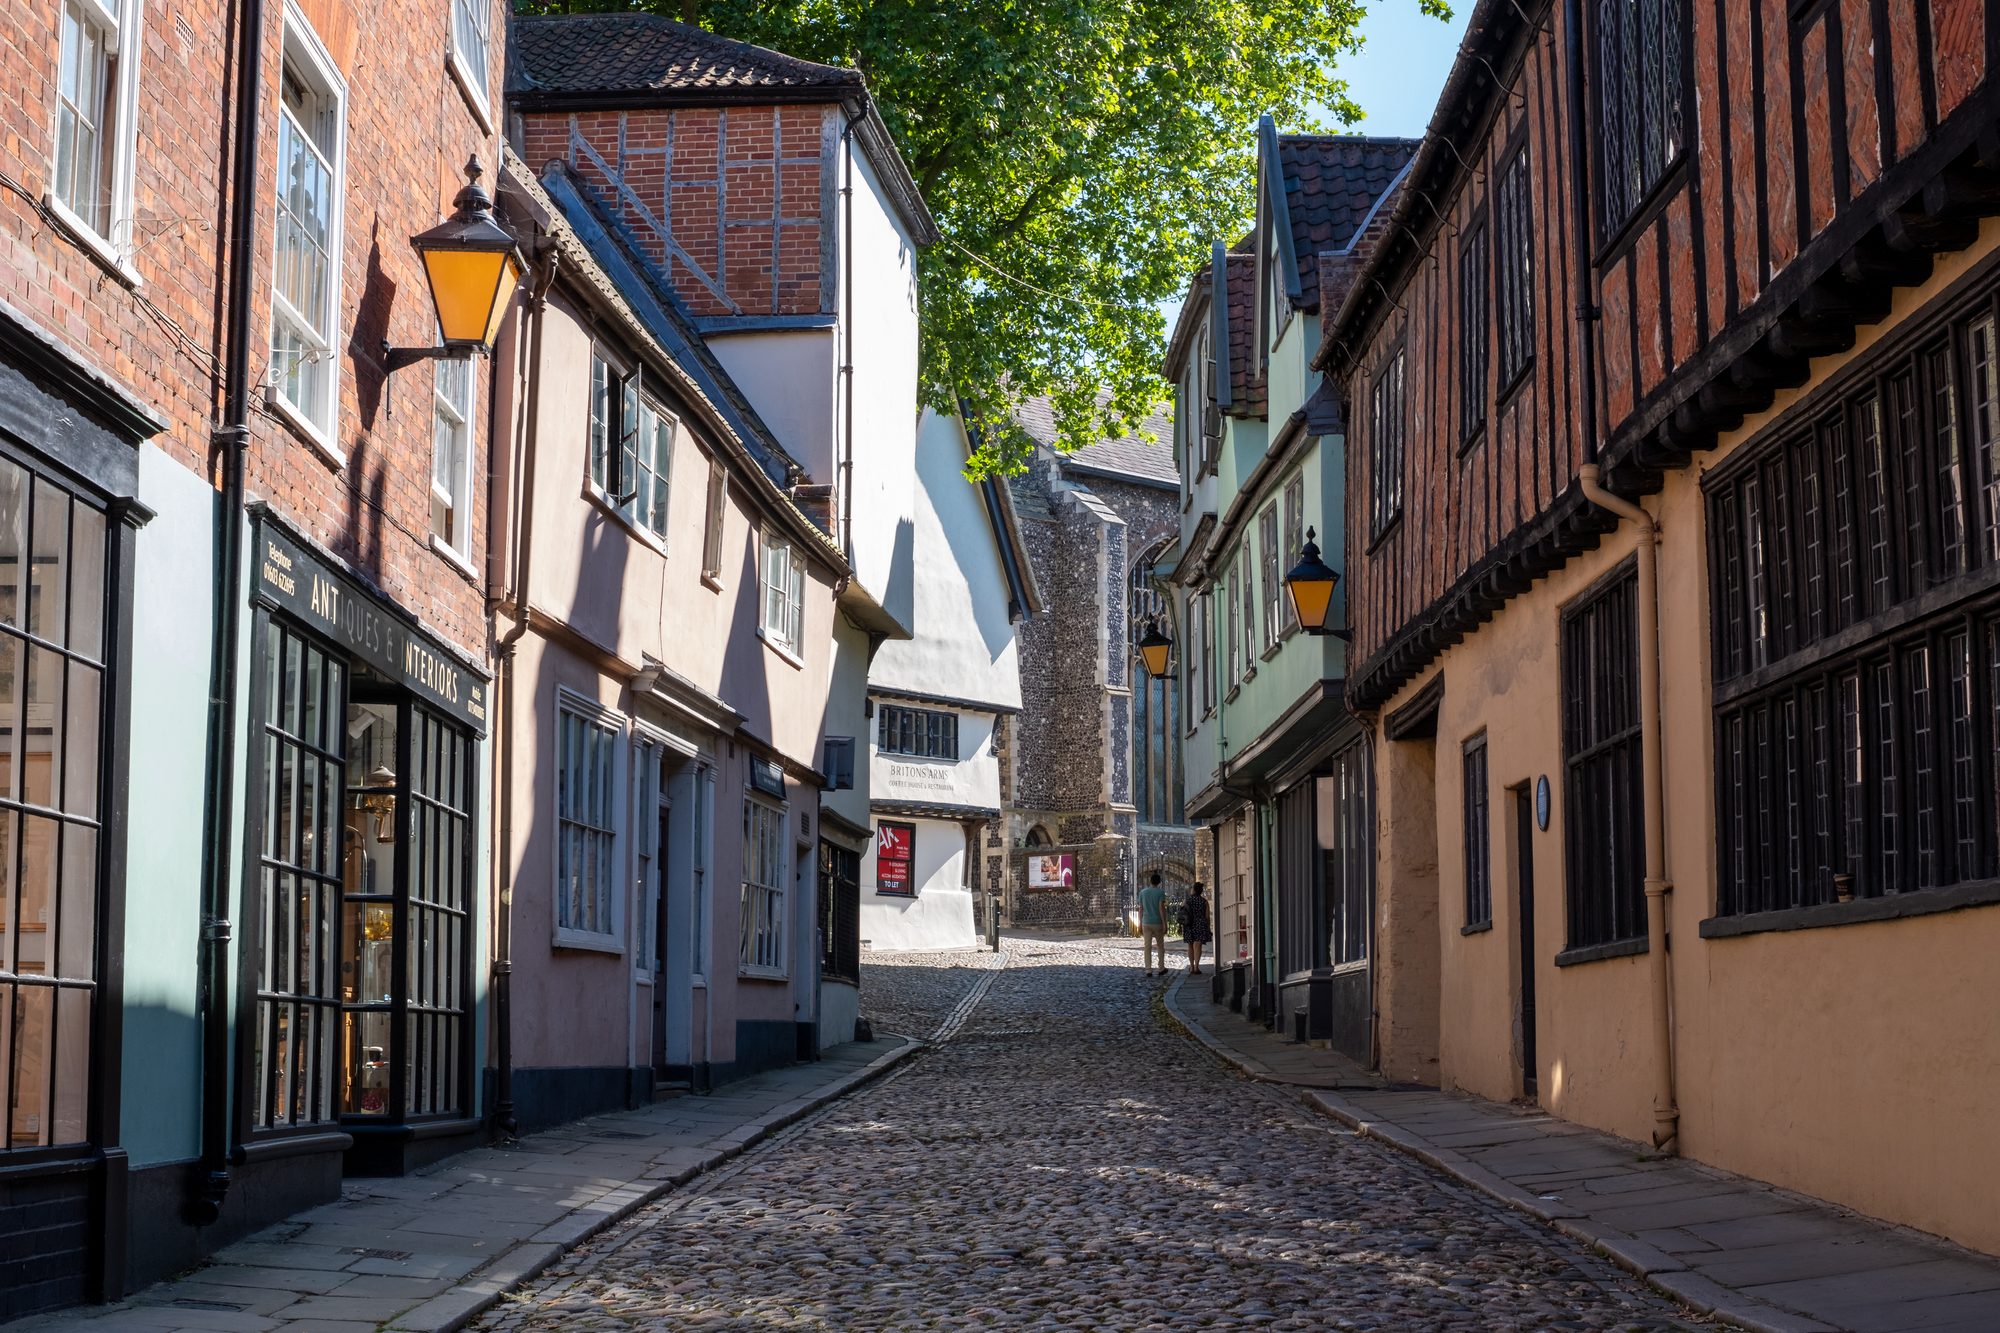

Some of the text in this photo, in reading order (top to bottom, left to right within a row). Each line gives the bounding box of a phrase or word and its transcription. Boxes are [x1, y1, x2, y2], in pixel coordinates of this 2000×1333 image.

[268, 541, 292, 571] Telephone
[311, 573, 458, 704] ANTIQUES & INTERIORS
[928, 769, 949, 780] ARMS
[884, 880, 892, 888] TO
